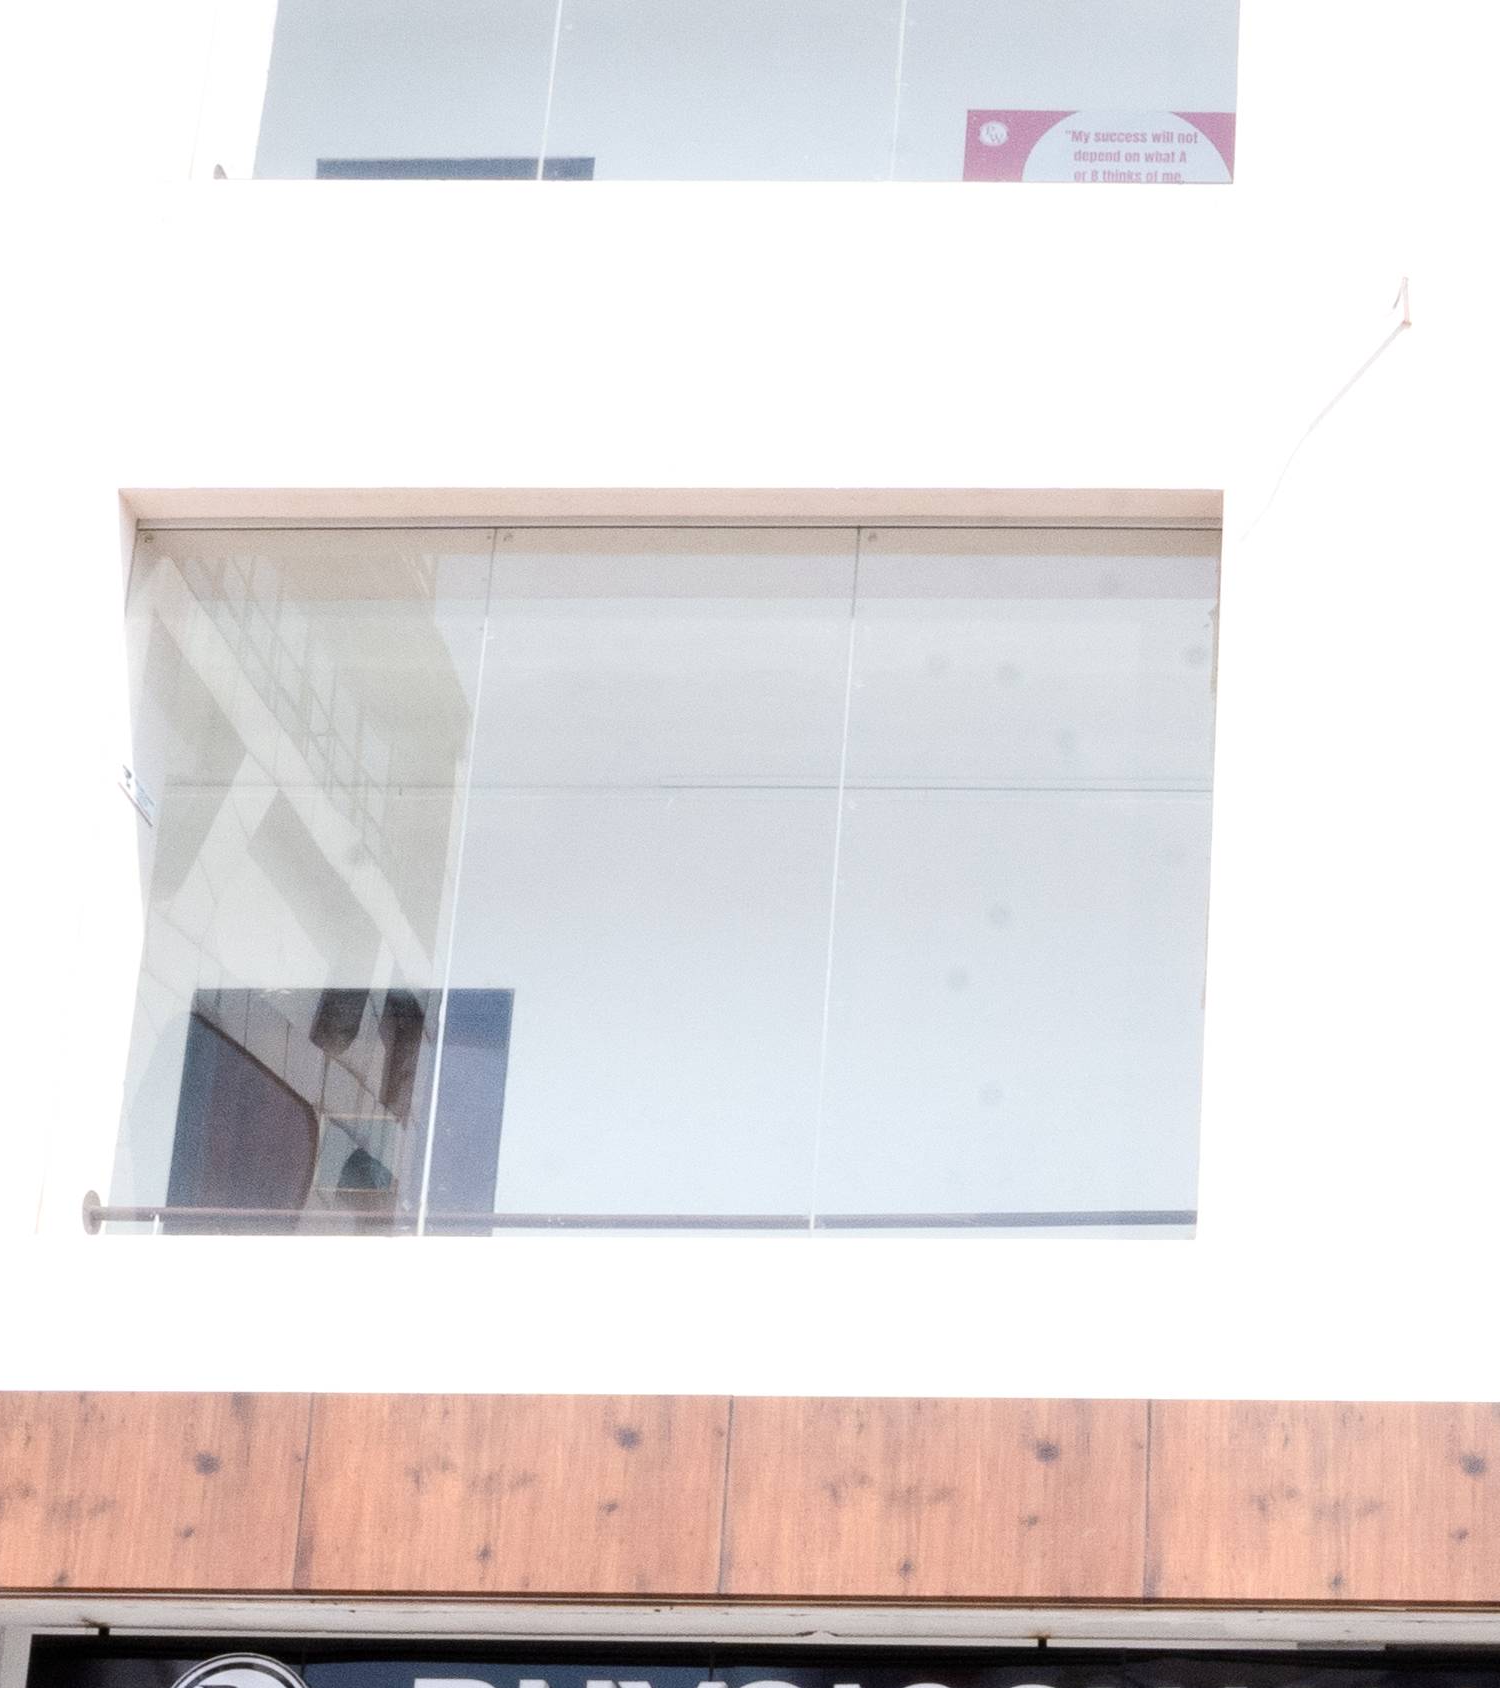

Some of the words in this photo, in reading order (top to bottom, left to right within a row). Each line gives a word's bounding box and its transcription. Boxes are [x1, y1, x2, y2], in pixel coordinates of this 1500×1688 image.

[1093, 130, 1148, 144] success
[1151, 129, 1175, 144] will
[1177, 130, 1199, 145] not
[1073, 150, 1121, 164] depend
[1124, 151, 1141, 163] on
[1144, 150, 1175, 163] what
[1102, 169, 1142, 183] thinks
